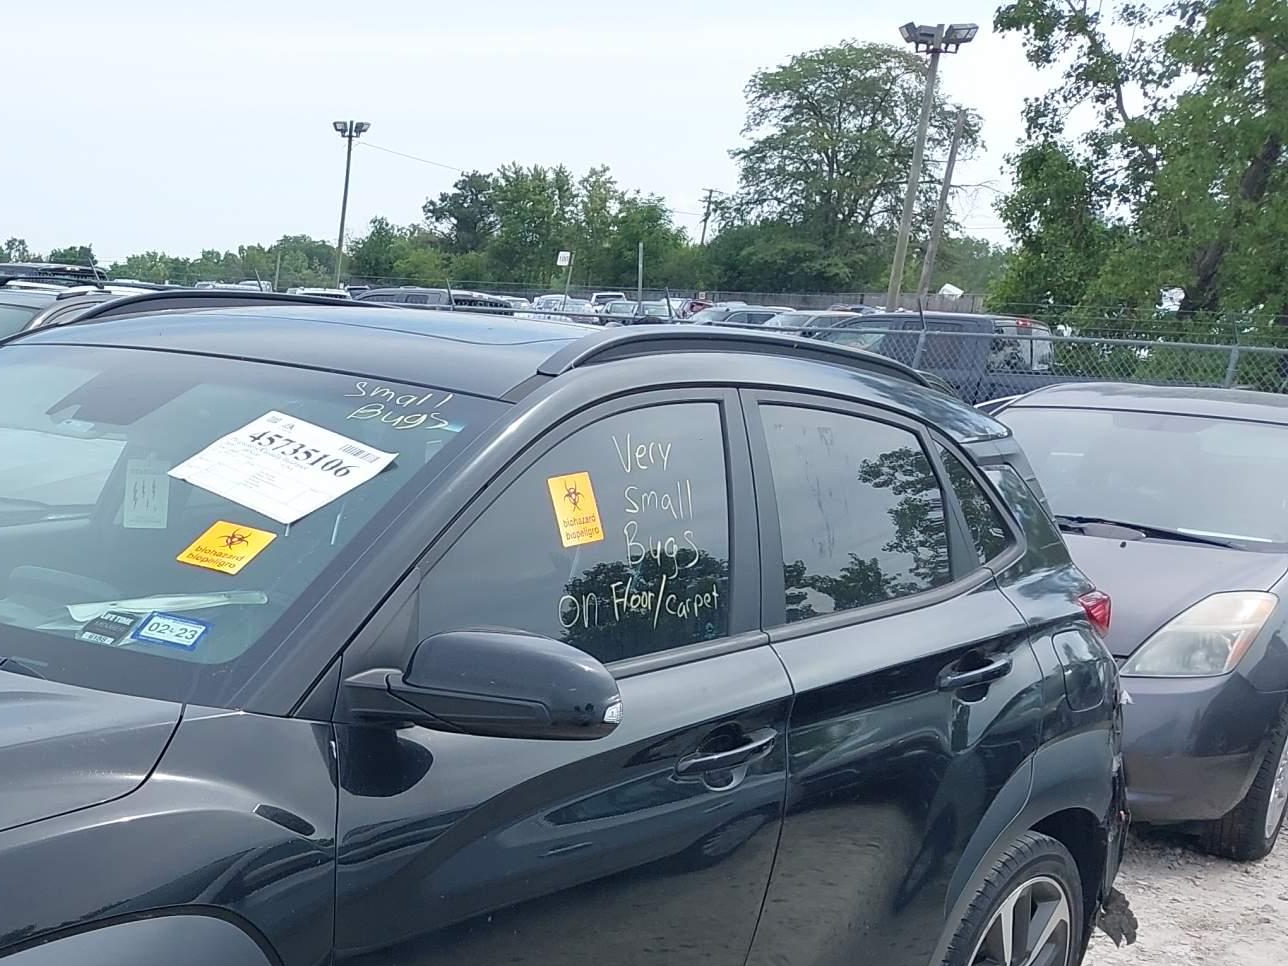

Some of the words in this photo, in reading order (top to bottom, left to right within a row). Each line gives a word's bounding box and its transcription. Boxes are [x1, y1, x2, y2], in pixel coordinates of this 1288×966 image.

[346, 403, 449, 430] Bugs
[247, 428, 362, 478] 45735106
[612, 432, 673, 473] Very
[562, 513, 597, 528] biohazard
[565, 527, 601, 541] biopeligro
[186, 553, 237, 569] biopeligro
[194, 544, 246, 562] biohazard
[623, 521, 700, 580] Bugs
